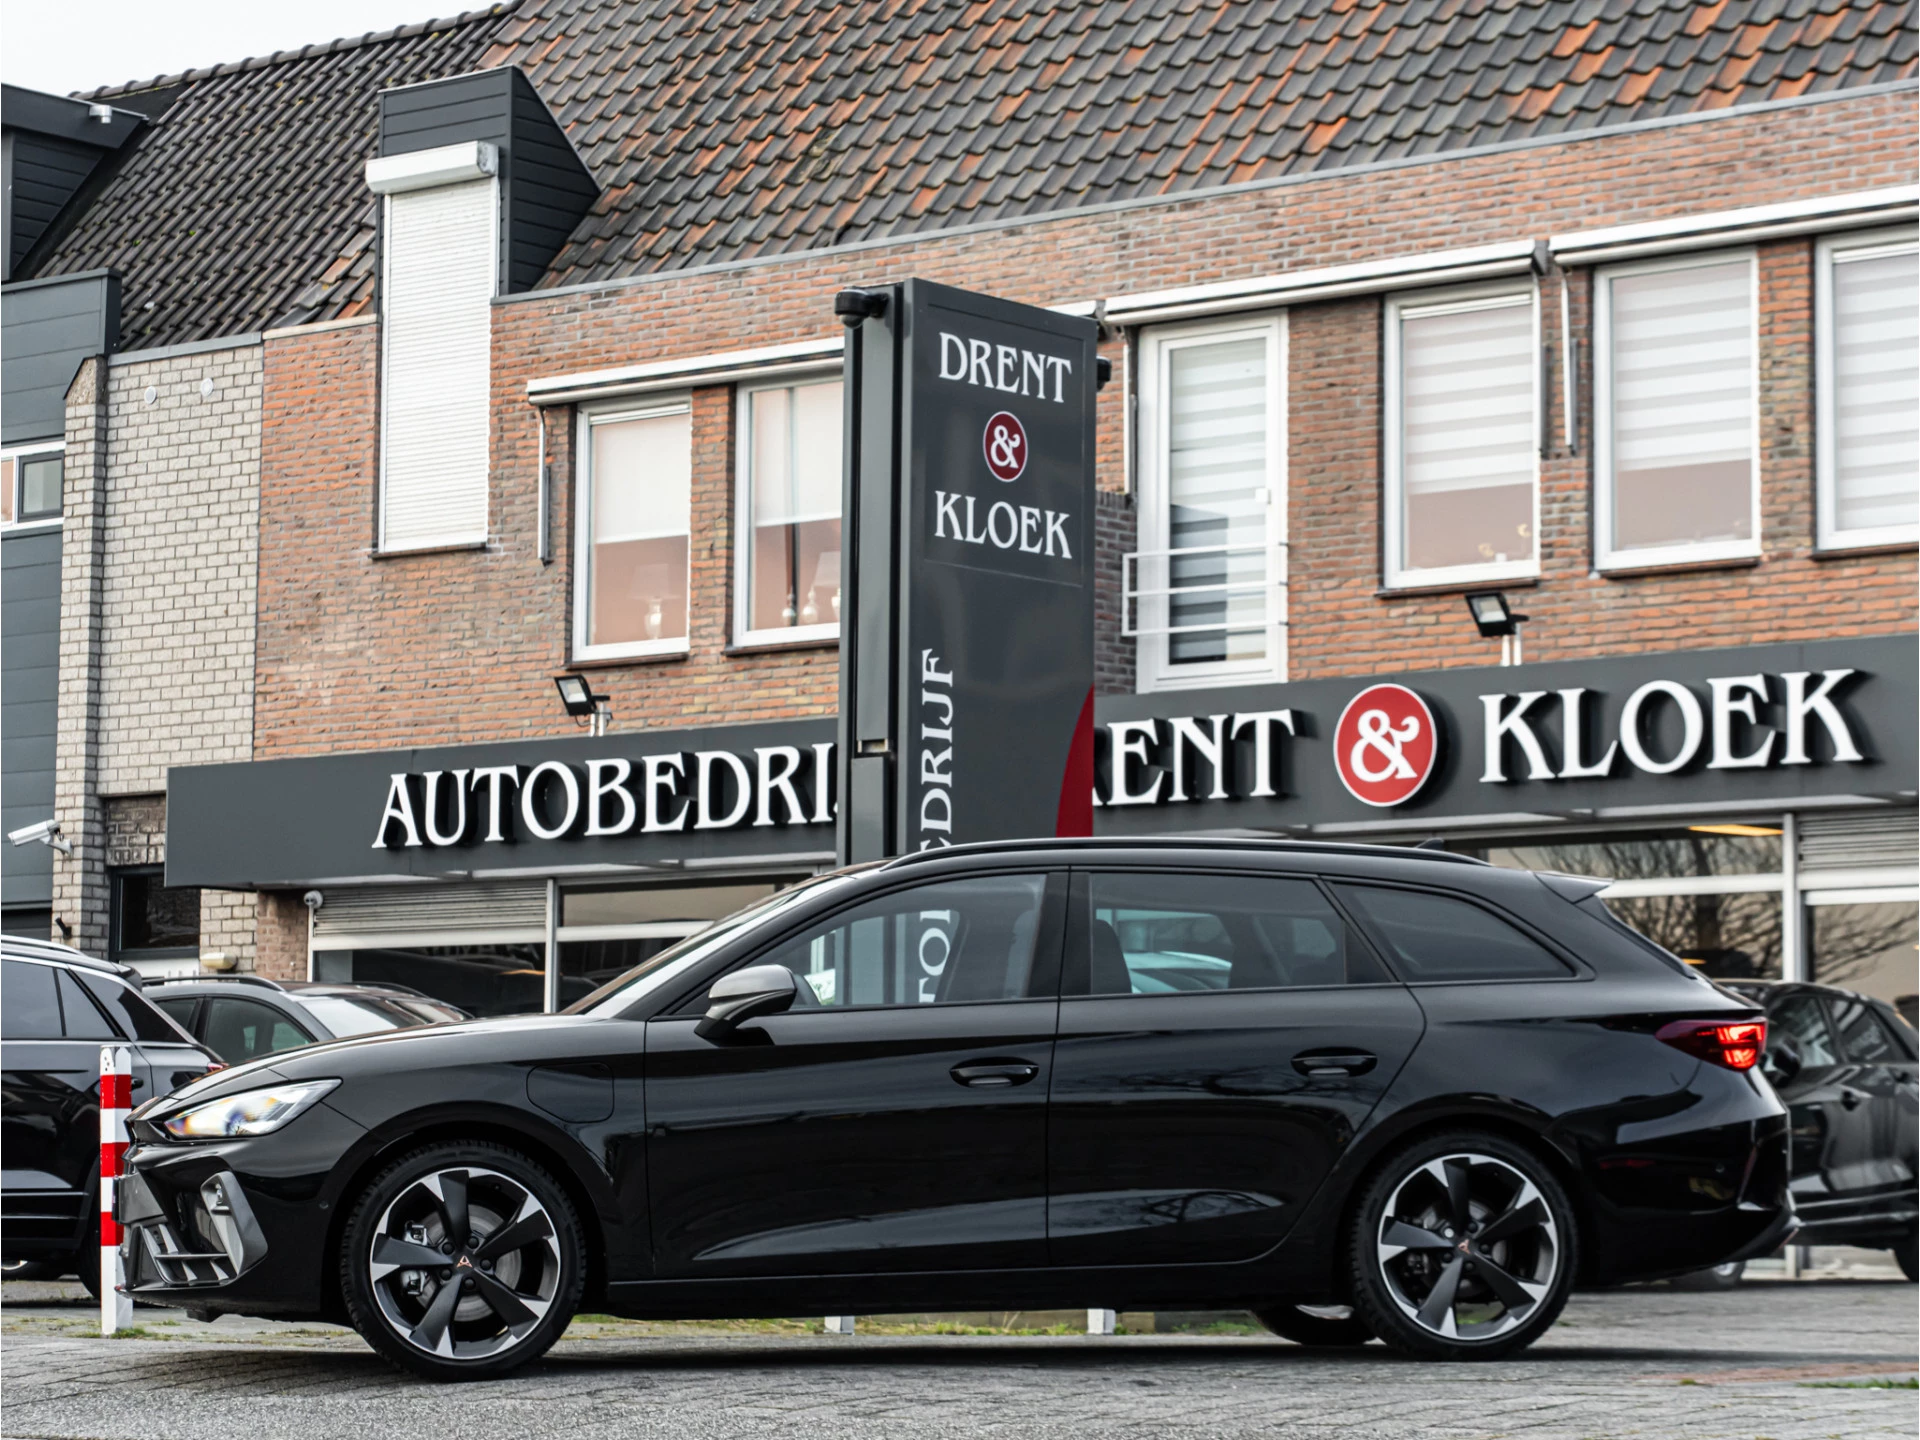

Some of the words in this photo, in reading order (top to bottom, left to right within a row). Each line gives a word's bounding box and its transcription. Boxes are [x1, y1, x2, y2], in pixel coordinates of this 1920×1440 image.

[938, 331, 1072, 403] DRENT
[990, 425, 1021, 469] &
[934, 490, 1073, 559] KLOEK
[371, 742, 838, 849] AUTOBEDRI
[1092, 708, 1295, 806] ENT
[1350, 709, 1420, 782] &
[1478, 668, 1863, 783] KLOEK
